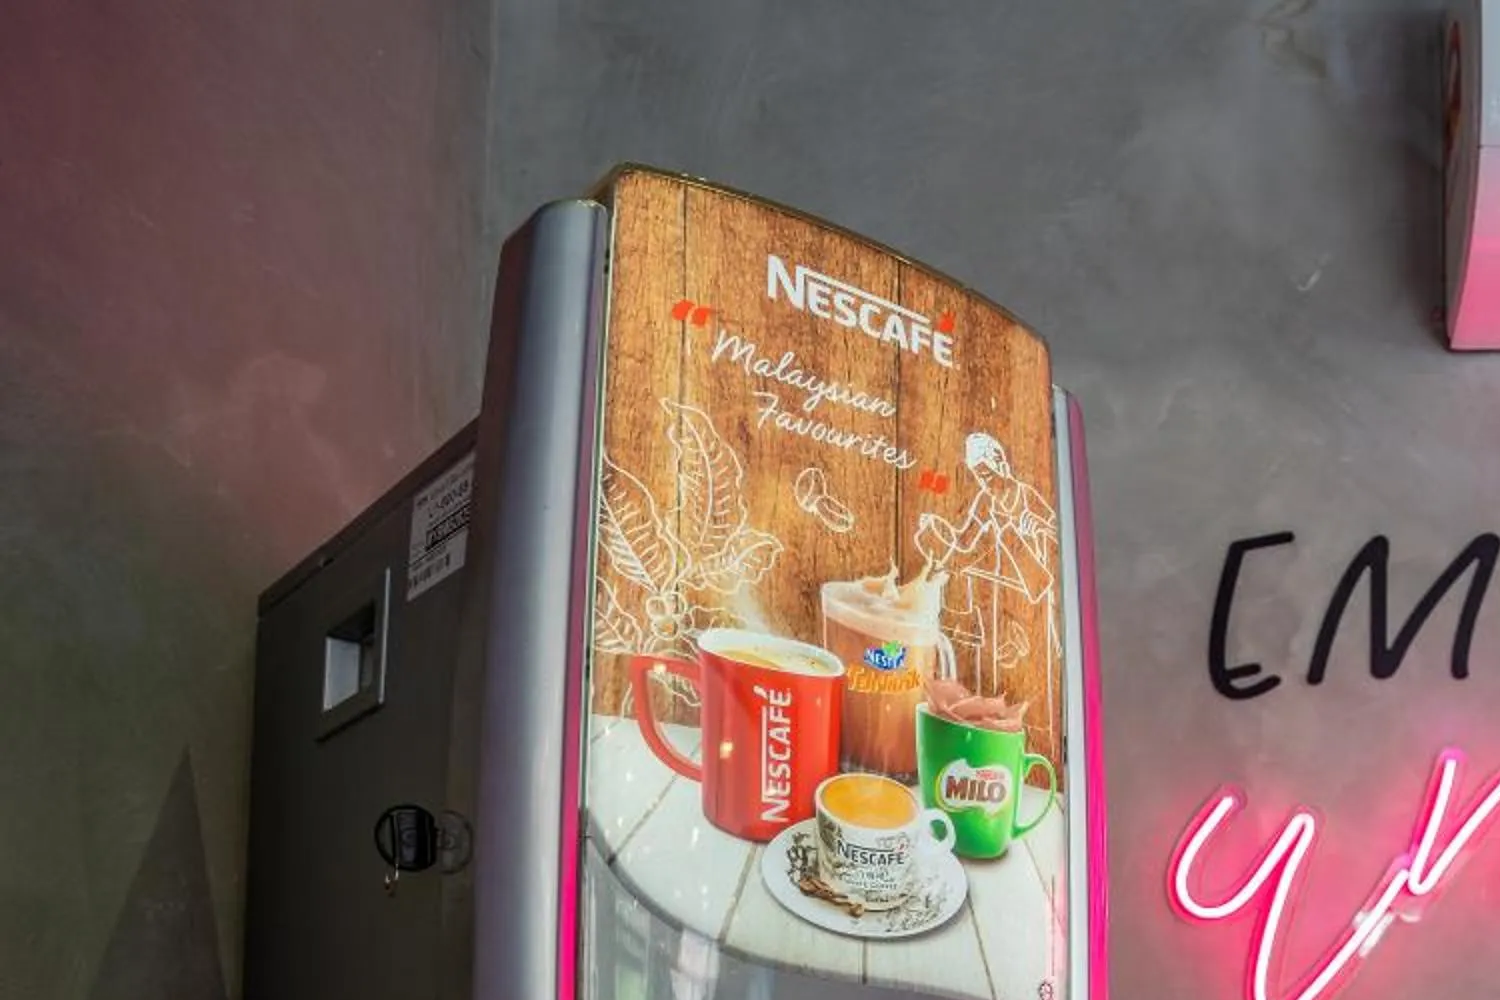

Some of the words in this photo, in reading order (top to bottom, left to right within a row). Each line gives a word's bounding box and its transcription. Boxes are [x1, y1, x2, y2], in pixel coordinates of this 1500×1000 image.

[711, 328, 898, 418] Malaysian
[753, 390, 918, 470] Favourites
[752, 684, 794, 823] NESCAFÉ
[945, 775, 1007, 803] MILO
